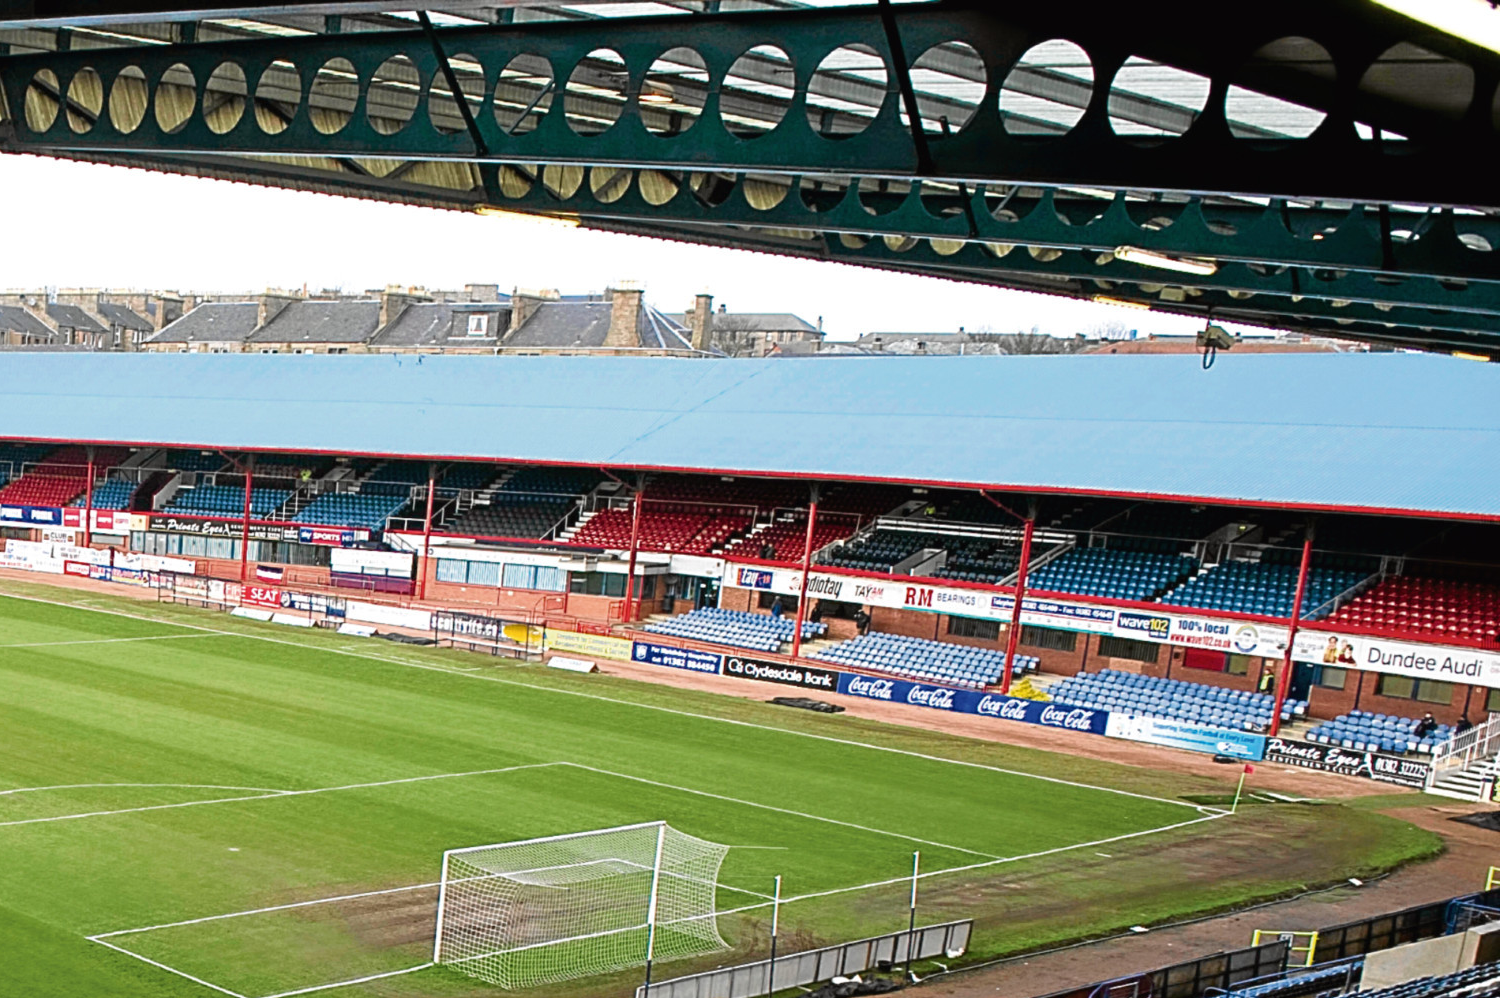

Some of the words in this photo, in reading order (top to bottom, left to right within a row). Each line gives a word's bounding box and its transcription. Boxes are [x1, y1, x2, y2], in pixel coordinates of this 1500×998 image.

[166, 518, 200, 532] Private
[300, 530, 312, 541] sky
[313, 531, 341, 542] SPORTS
[250, 587, 278, 602] SEAT
[904, 587, 934, 608] RM
[936, 592, 976, 607] BEARINGS
[1119, 617, 1169, 633] wave102
[1178, 620, 1203, 632] 100%
[1204, 622, 1230, 635] local
[1170, 633, 1231, 649] www.wave102.co.uk
[663, 656, 686, 668] 01382
[1367, 647, 1437, 671] Dundee
[1440, 657, 1483, 677] Audi
[744, 662, 803, 684] Clydesdale
[804, 673, 833, 687] Bank
[1199, 727, 1219, 738] Football
[1265, 754, 1331, 771] GENTLEMEN'S
[1266, 738, 1321, 760] Private
[1324, 748, 1360, 771] Eyes
[1374, 757, 1397, 774] 01382
